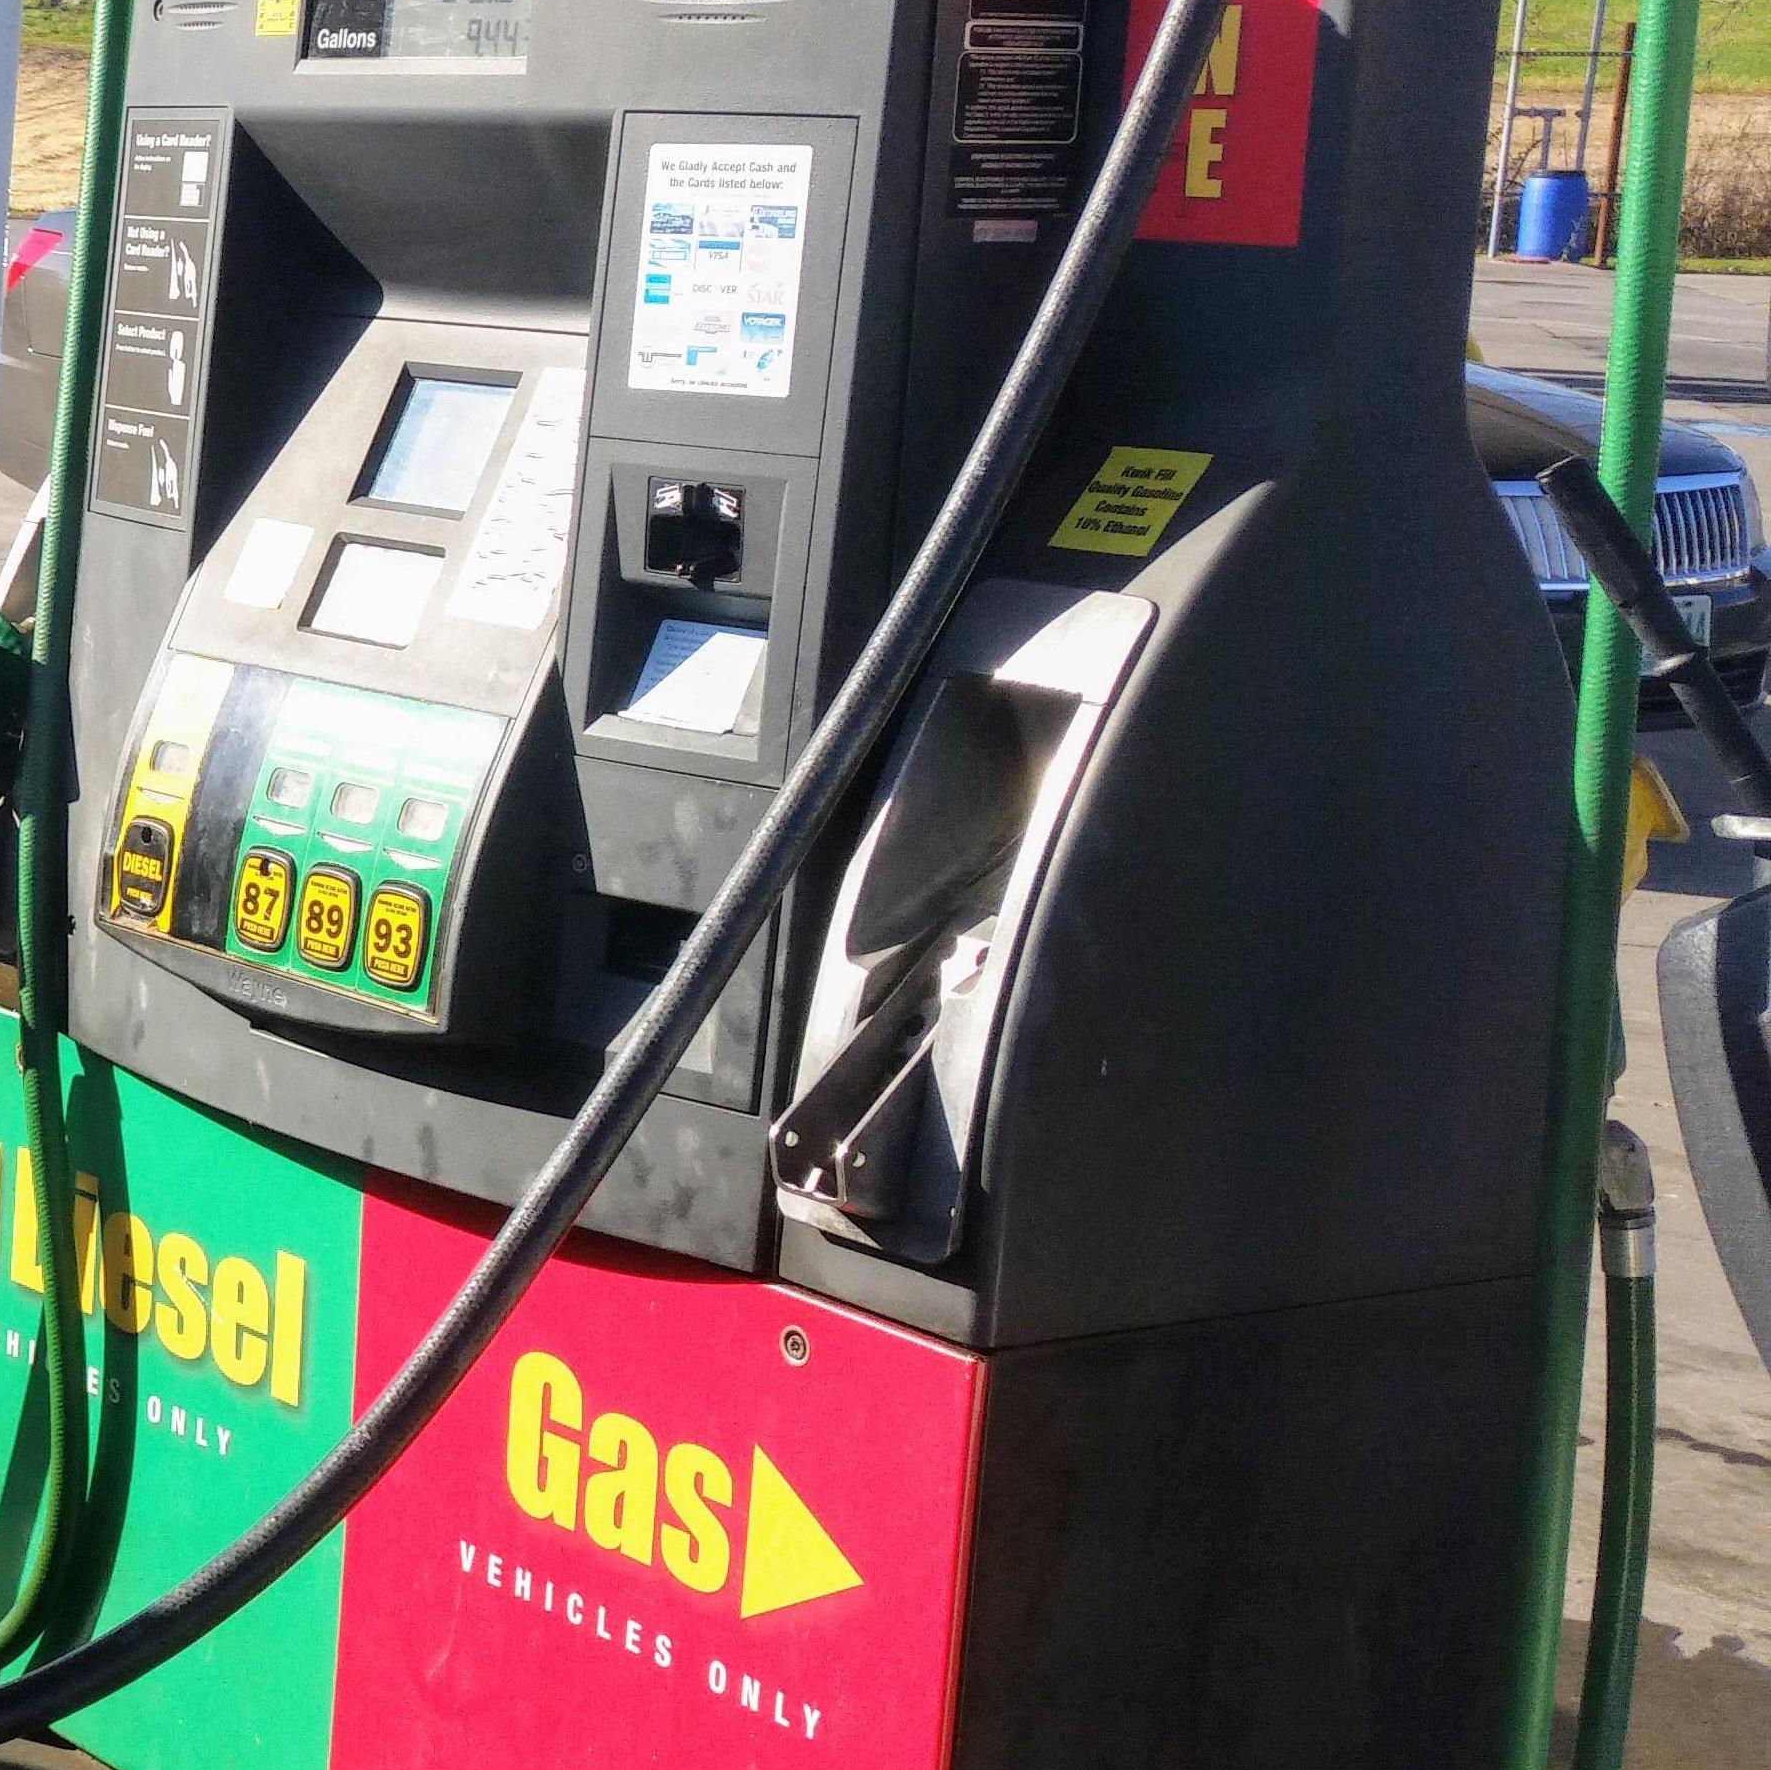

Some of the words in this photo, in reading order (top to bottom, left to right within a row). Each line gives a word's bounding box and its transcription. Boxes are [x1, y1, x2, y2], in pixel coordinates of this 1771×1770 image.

[317, 28, 377, 49] Gallons
[662, 160, 675, 171] We
[679, 160, 708, 173] Gladly
[712, 161, 746, 173] Accept
[749, 162, 774, 173] Cash
[777, 163, 797, 173] and
[669, 177, 684, 187] the
[688, 178, 715, 188] Cards
[719, 178, 746, 188] listed
[1087, 481, 1131, 498] Quality
[1131, 485, 1184, 501] Gasoline
[123, 851, 163, 882] DIESEL
[243, 882, 280, 921] 87
[306, 900, 344, 939] 89
[373, 918, 413, 959] 93
[147, 1395, 231, 1456] ONLY
[506, 1351, 735, 1596] Gas
[460, 1540, 673, 1668] VEHICLES
[708, 1661, 822, 1741] ONLY
